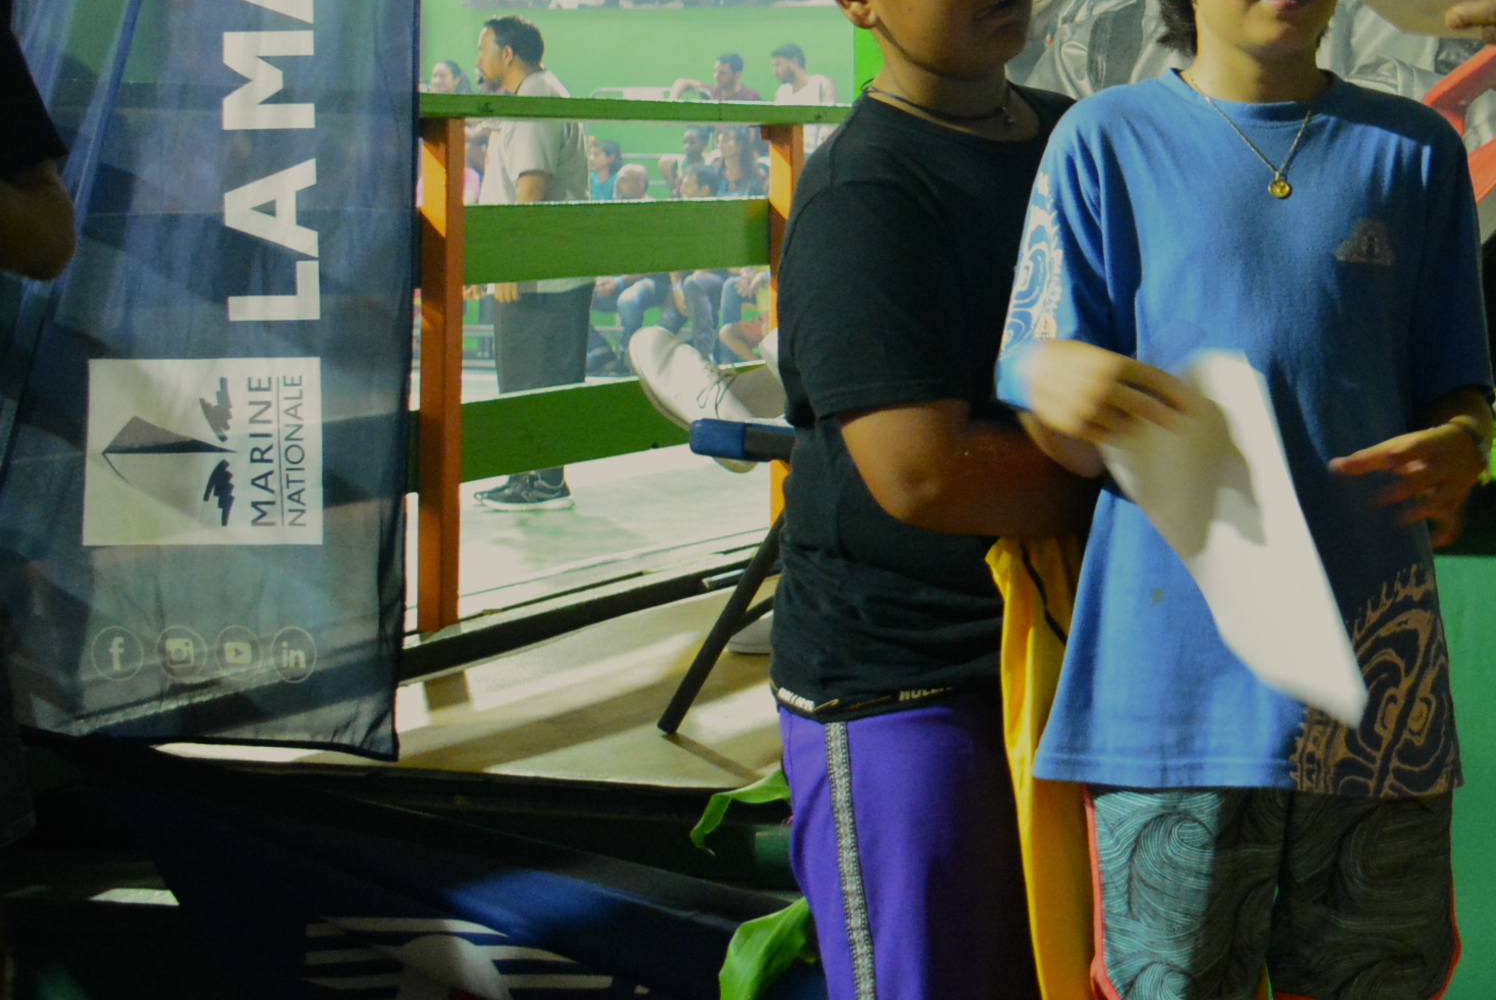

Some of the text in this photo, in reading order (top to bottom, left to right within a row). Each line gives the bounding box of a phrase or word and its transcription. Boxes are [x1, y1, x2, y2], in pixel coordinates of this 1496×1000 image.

[223, 158, 321, 321] LA
[247, 376, 277, 527] MARINE
[283, 374, 308, 527] NATIONALE
